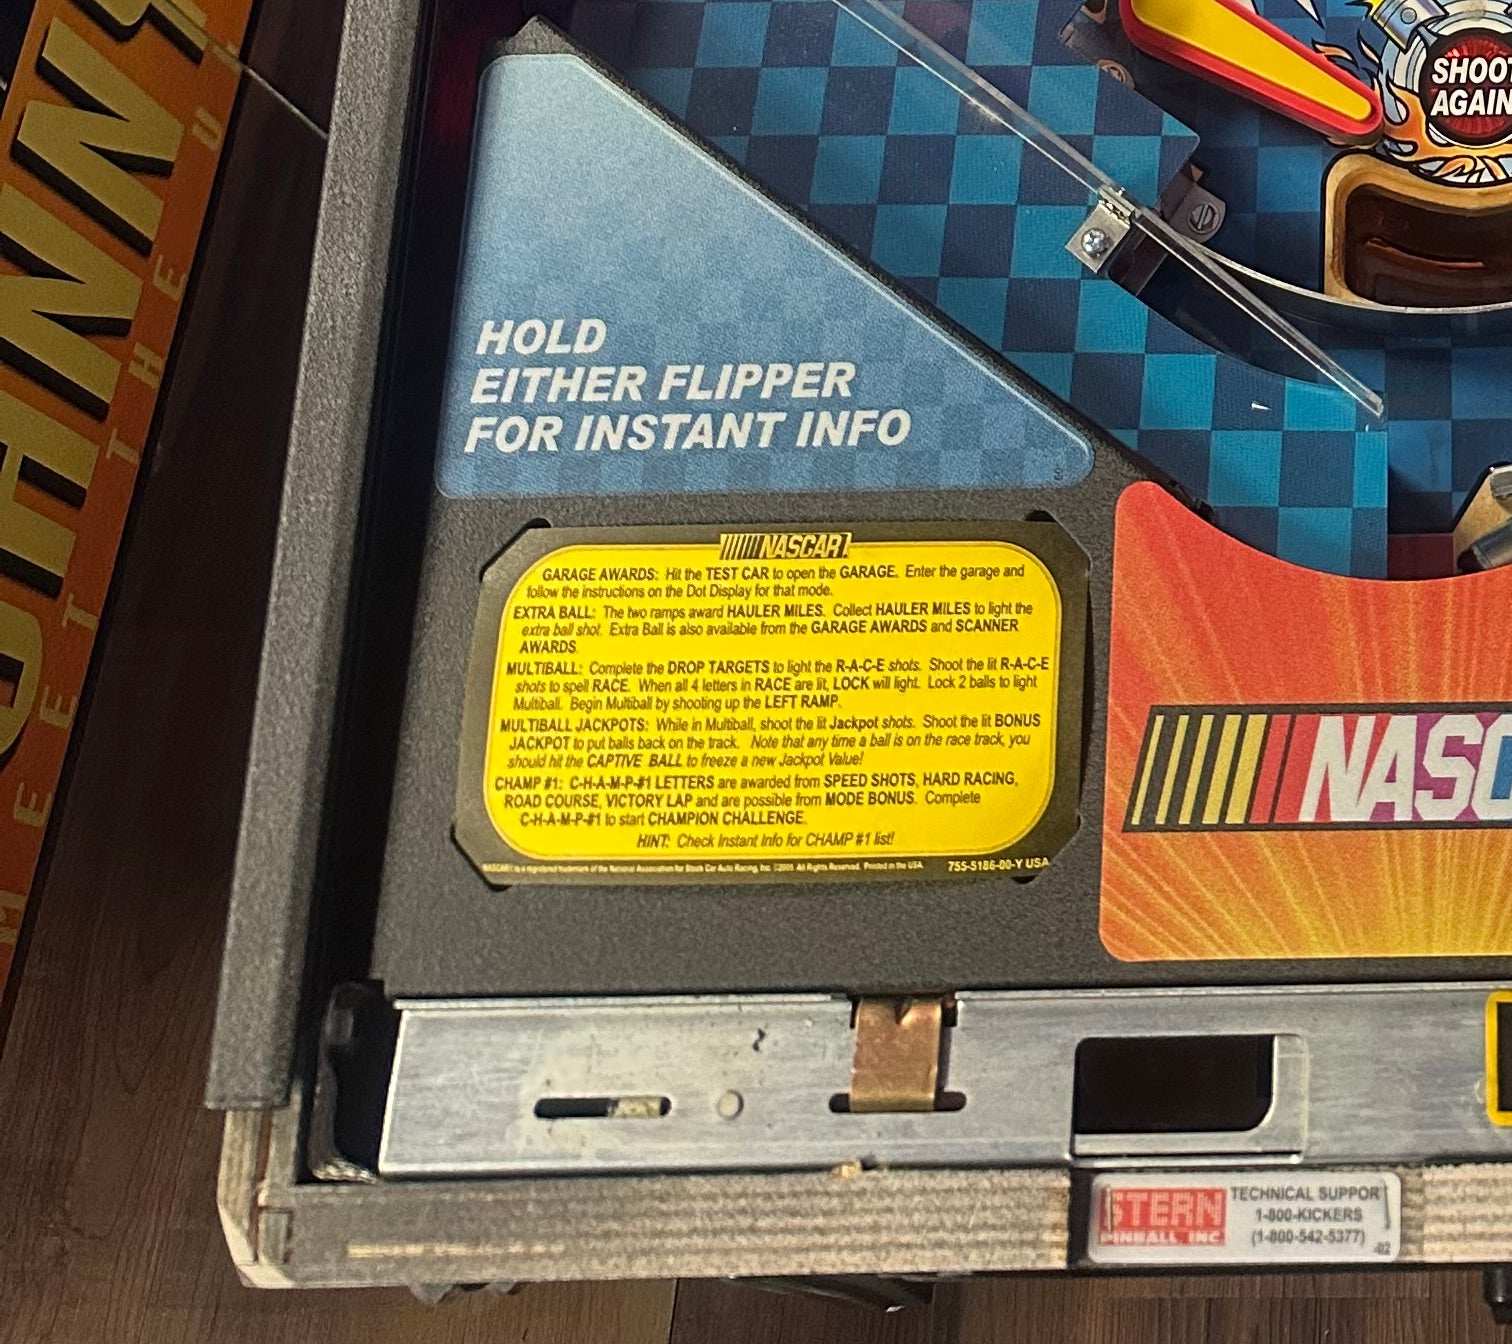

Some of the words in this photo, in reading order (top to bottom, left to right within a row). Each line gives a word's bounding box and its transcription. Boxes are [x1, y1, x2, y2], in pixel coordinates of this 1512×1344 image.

[474, 318, 608, 356] HOLD
[469, 365, 650, 405] EITHER
[657, 361, 858, 401] FLIPPER
[463, 415, 567, 454] FOR
[573, 411, 788, 452] INSTANT
[794, 408, 913, 449] INFO
[758, 532, 848, 560] NASCAR
[542, 567, 596, 582] GARAGE
[599, 566, 659, 581] AWARDS:
[706, 566, 738, 581] TEST
[741, 566, 769, 581] CAR
[955, 618, 1019, 633] SCANNER
[667, 660, 705, 675] DROP
[708, 659, 770, 675] TARGETS
[1231, 1186, 1315, 1202] TECHNICAL
[1255, 1207, 1363, 1224] 1-800-KICKERS
